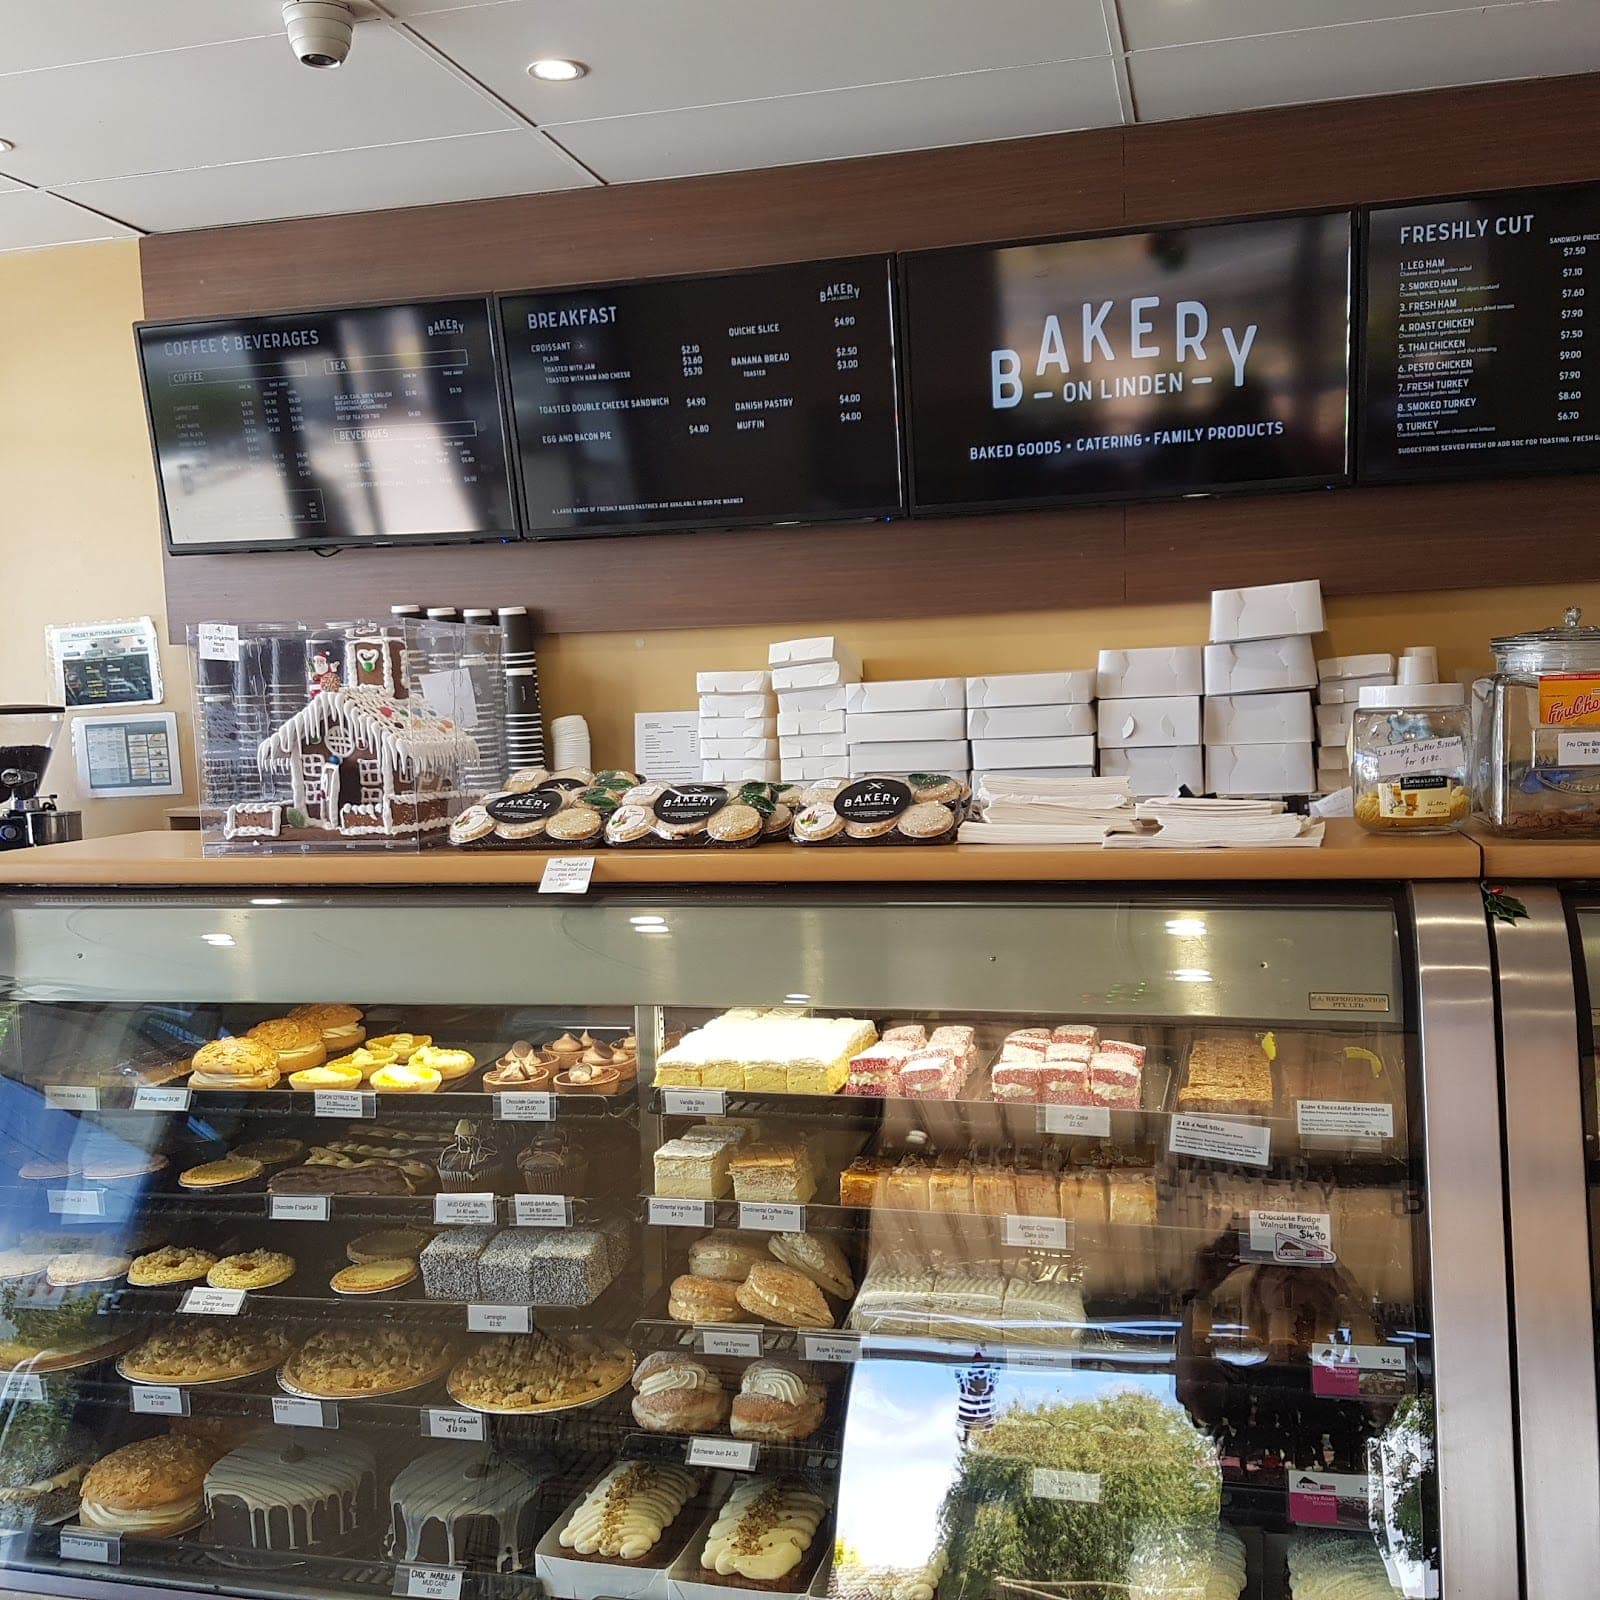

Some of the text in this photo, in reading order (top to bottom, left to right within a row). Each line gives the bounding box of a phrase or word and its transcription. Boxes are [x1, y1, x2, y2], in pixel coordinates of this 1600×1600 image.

[1400, 215, 1534, 244] FRESHLY CUT
[1549, 235, 1581, 244] SANDWICH
[1563, 246, 1586, 257] $7.50
[1407, 260, 1425, 270] LEG
[1425, 258, 1445, 268] HAM
[1562, 268, 1583, 277] $7.10
[1408, 280, 1439, 290] SMOKED
[1440, 278, 1458, 287] HAM
[819, 283, 860, 303] BAKERY
[1562, 288, 1585, 298] $7.60
[1408, 300, 1436, 311] FRESH
[1437, 298, 1457, 308] HAM
[528, 306, 617, 329] BREAKFAST
[1561, 309, 1583, 319] $7.90
[428, 318, 465, 336] BAKERY
[834, 316, 855, 327] $4.90
[1399, 318, 1475, 332] 4. ROAST CHICKEN
[728, 323, 780, 337] QUICHE SLICE
[1560, 329, 1583, 340] $7.50
[164, 329, 320, 356] COFFEE & BEVERAGES
[531, 342, 571, 353] CROISSANT
[1398, 343, 1406, 353] 5.
[1408, 342, 1428, 352] THAI
[1428, 339, 1466, 350] CHICKEN
[991, 296, 1258, 409] BAKERY
[1560, 351, 1582, 360] $9.00
[542, 355, 560, 363] PLAIN
[731, 353, 790, 366] BANANA BREAD
[837, 360, 858, 370] $3.00
[330, 361, 347, 372] TEA
[544, 363, 596, 373] TOASTED WITH JAM
[1398, 359, 1472, 373] 6. PESTO CHICKEN
[173, 371, 204, 383] COFFEE
[545, 376, 570, 385] TOASTED
[570, 375, 584, 383] WITH
[610, 371, 631, 379] CHEESE
[1559, 371, 1581, 380] $7.90
[1063, 372, 1183, 402] ON LINDEN
[1407, 381, 1434, 391] FRESH
[1436, 379, 1469, 389] TURKEY
[839, 393, 861, 404] $4.00
[1558, 391, 1581, 401] $8.60
[539, 397, 670, 415] TOASTED DOUBLE CHEESE SANDWICH
[686, 397, 707, 408] $4.90
[735, 398, 794, 411] DANISH PASTRY
[1397, 398, 1477, 411] 8. SMOKED TURKEY
[840, 411, 862, 422] $4.00
[1557, 411, 1579, 421] $6.70
[737, 419, 765, 430] MUFFIN
[1397, 420, 1439, 431] 9. TURKEY
[339, 429, 389, 441] BEVERAGES
[542, 431, 612, 444] EGG AND BACON PIE
[970, 422, 1284, 460] BAKED GOODS CATERING FAMILY PRODUCTS
[1398, 445, 1440, 454] SUGGESTIONS
[1441, 443, 1465, 451] SERVED
[1466, 441, 1486, 449] FRESH
[1390, 746, 1410, 757] single
[1413, 743, 1435, 753] Butter
[1405, 757, 1416, 768] for
[495, 798, 551, 810] BAKERY
[663, 794, 717, 807] BAKERY
[844, 792, 900, 808] BAKERY
[1258, 1212, 1321, 1223] Chocolate Fudge
[1260, 1221, 1320, 1230] Walnut Brownie
[1381, 1357, 1402, 1365] $4.90
[438, 1416, 478, 1426] Cherry Crumble
